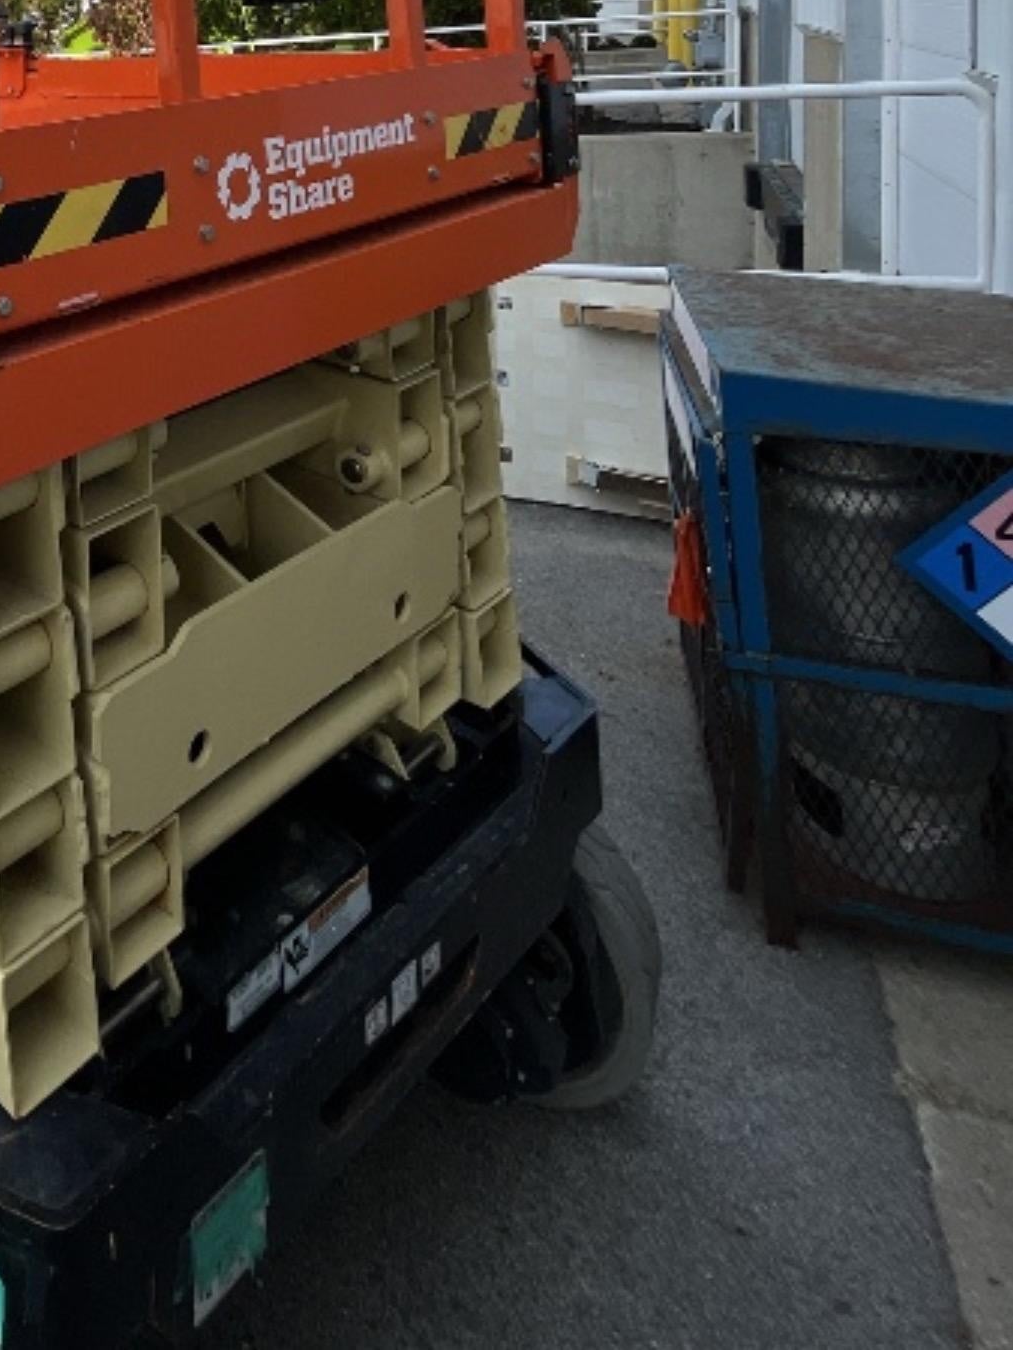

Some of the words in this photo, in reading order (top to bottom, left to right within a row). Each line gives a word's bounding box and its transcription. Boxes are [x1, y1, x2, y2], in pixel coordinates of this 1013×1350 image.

[263, 113, 417, 177] Equipment
[268, 173, 354, 220] Share
[955, 542, 978, 594] 1
